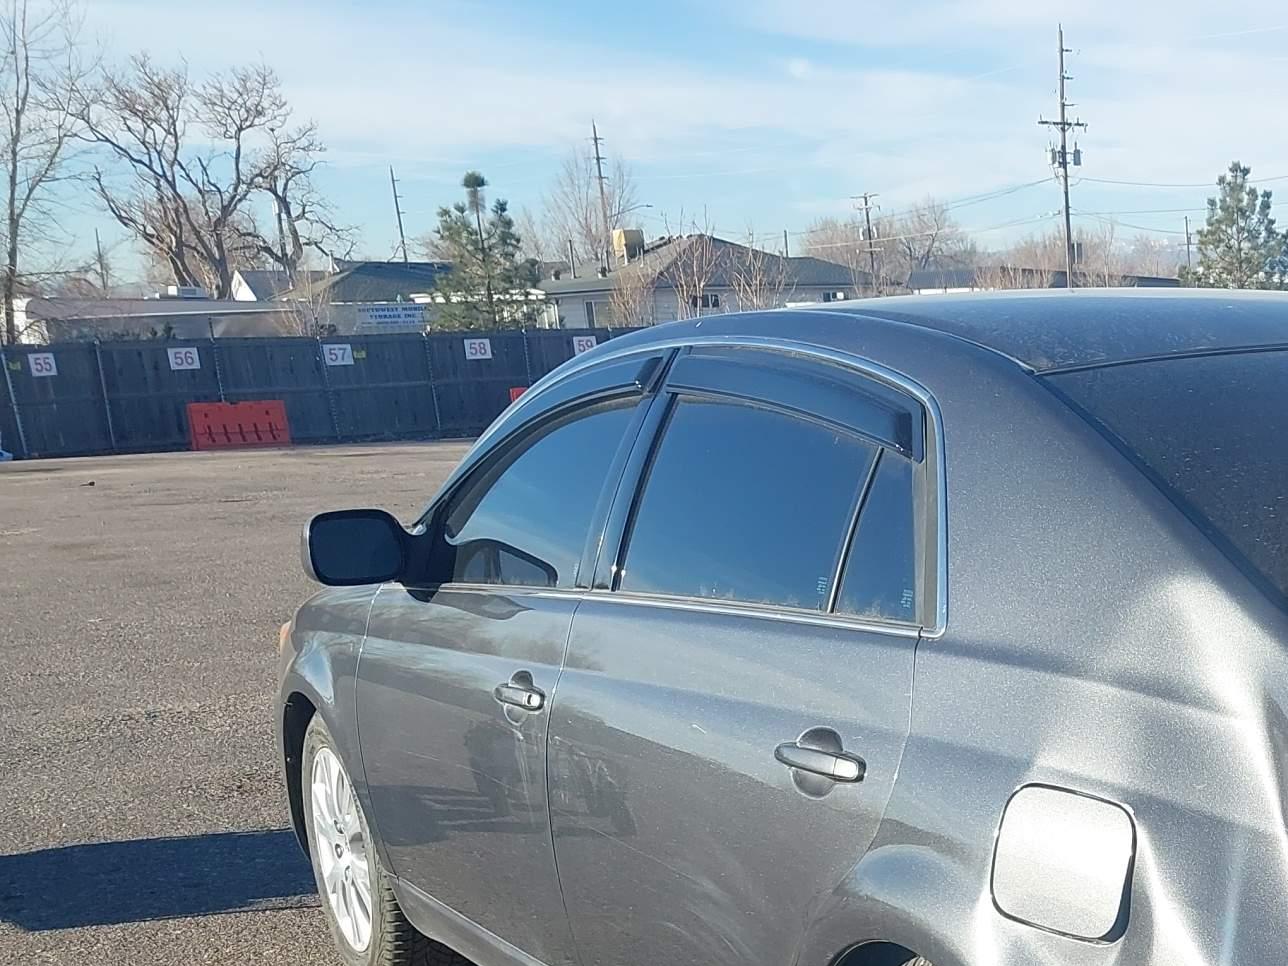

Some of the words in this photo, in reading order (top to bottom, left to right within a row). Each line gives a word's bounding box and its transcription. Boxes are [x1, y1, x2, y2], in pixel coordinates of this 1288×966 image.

[469, 341, 488, 356] 58
[577, 339, 593, 353] 59
[174, 351, 194, 367] 56
[328, 347, 347, 362] 57
[34, 357, 53, 373] 55
